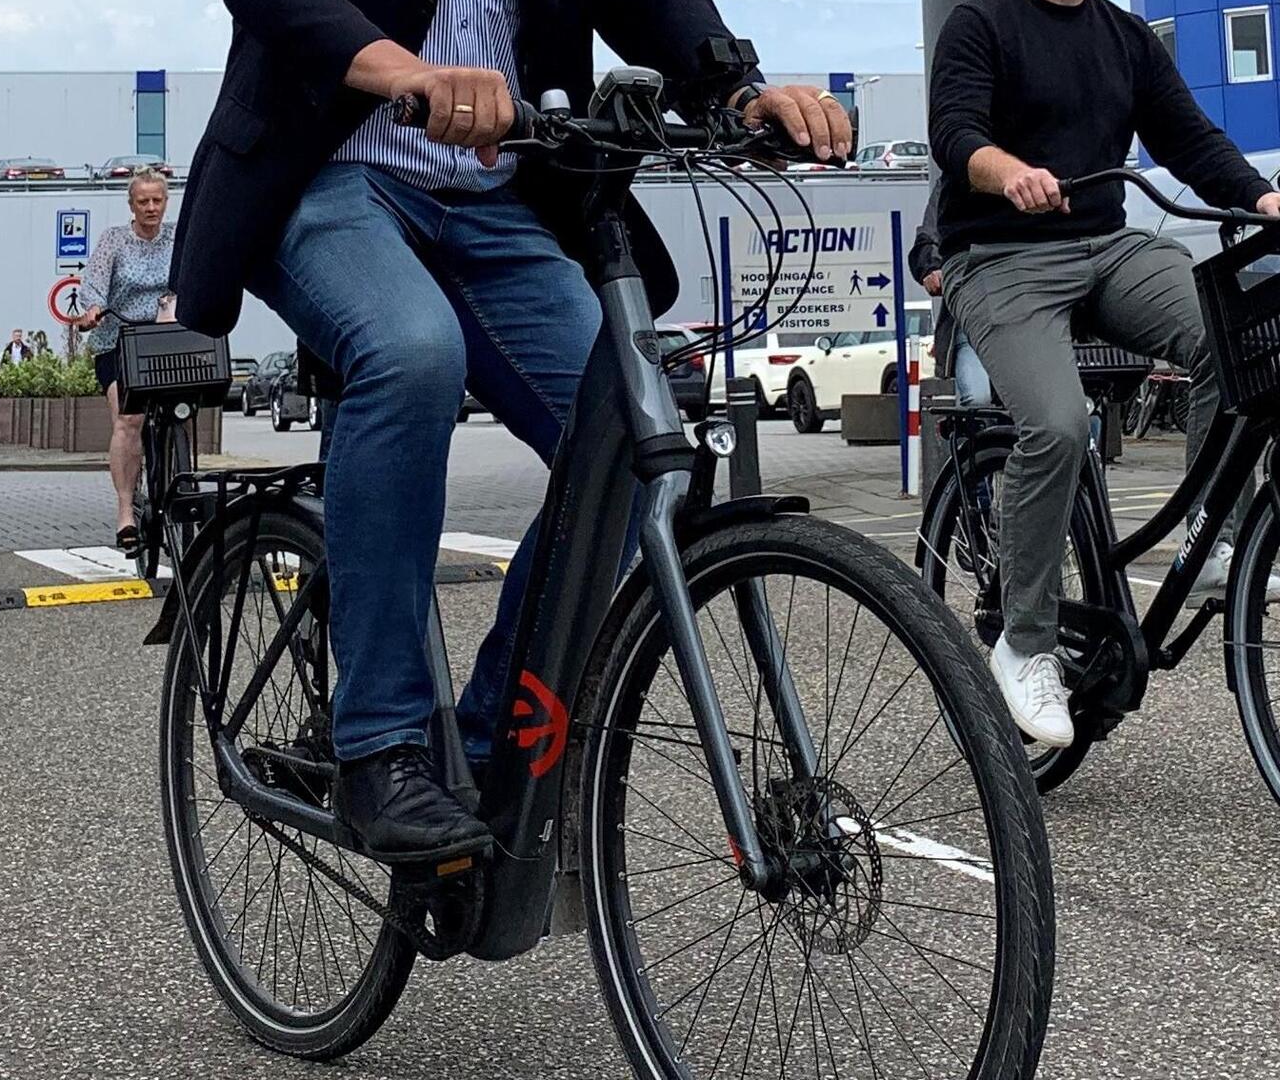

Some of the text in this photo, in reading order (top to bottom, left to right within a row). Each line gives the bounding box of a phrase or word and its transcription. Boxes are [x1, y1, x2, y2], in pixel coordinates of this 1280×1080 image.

[766, 227, 856, 253] ACTION
[774, 285, 835, 295] ENTRANCE
[778, 319, 831, 328] VISITORS
